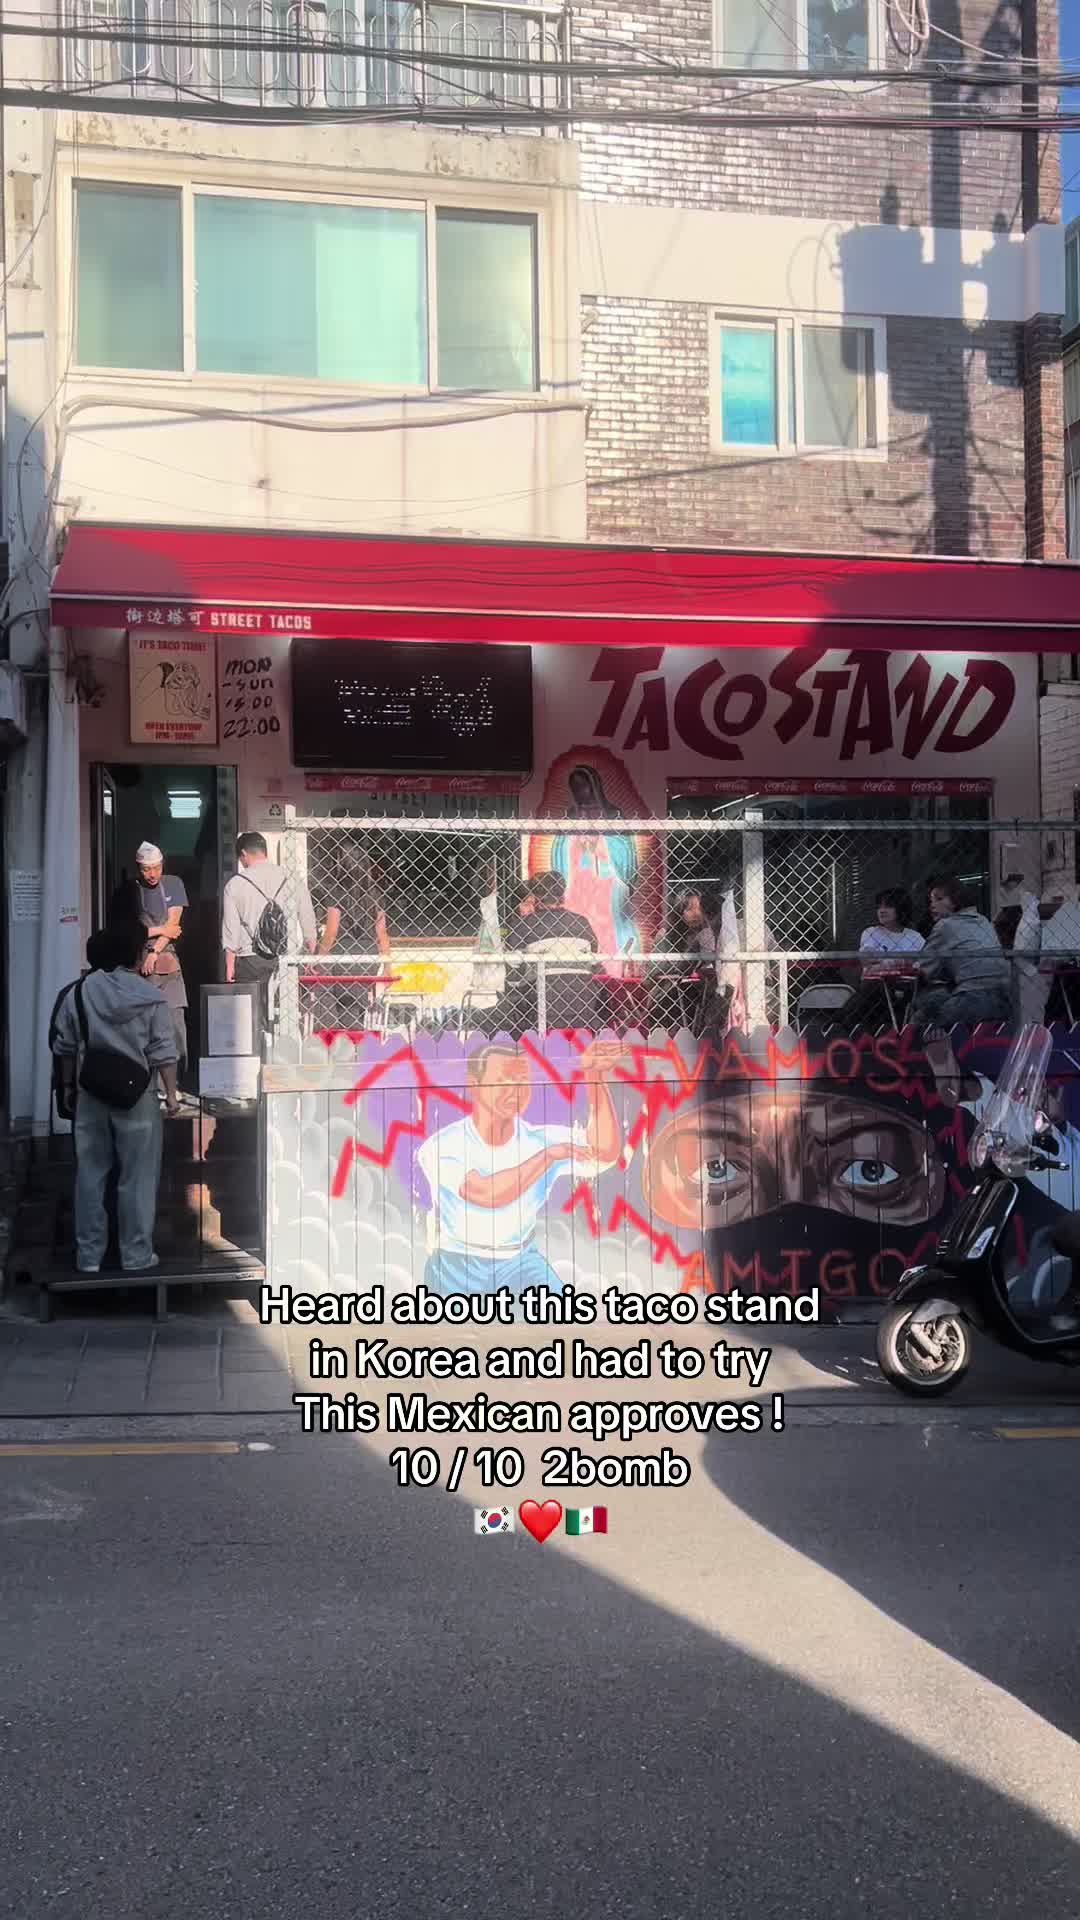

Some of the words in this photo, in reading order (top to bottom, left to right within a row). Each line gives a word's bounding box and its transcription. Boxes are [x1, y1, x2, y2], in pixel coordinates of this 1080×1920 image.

[210, 612, 262, 628] STREET
[270, 614, 312, 630] TACOS
[224, 656, 272, 676] MON
[590, 647, 768, 761] TACO
[768, 648, 1016, 761] STAND
[223, 715, 281, 739] 22:00
[664, 1036, 909, 1094] VAMOS
